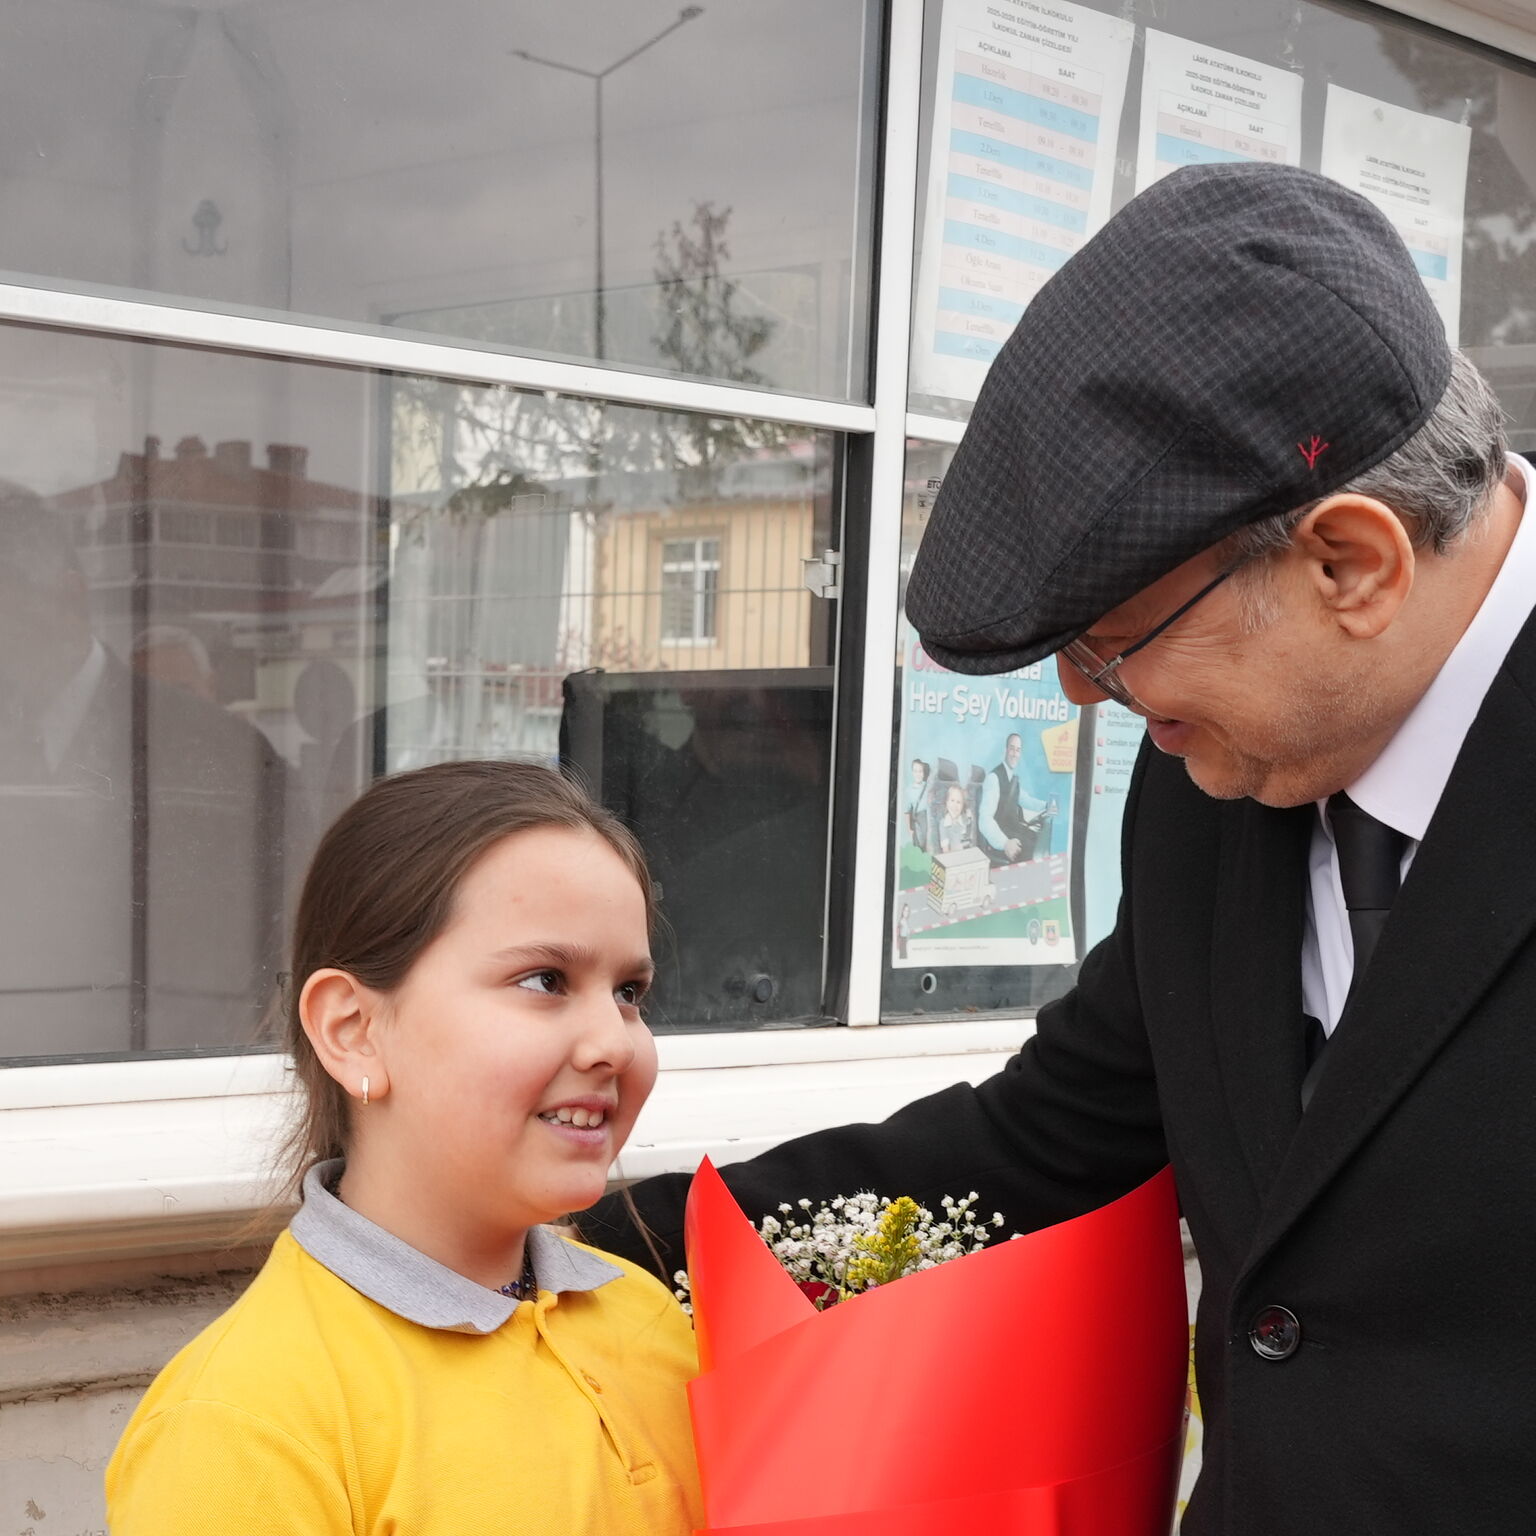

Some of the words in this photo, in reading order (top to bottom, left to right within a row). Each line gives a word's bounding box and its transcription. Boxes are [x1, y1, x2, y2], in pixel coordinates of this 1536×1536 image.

[1019, 31, 1041, 44] ZAMAN
[977, 41, 1012, 58] AÇIKLAMA
[1057, 67, 1077, 80] SAAT
[1177, 103, 1208, 117] AÇIKLAMA
[1248, 123, 1264, 135] SAAT
[910, 681, 949, 714] Her
[951, 684, 993, 725] Şey
[995, 687, 1069, 722] Yolunda
